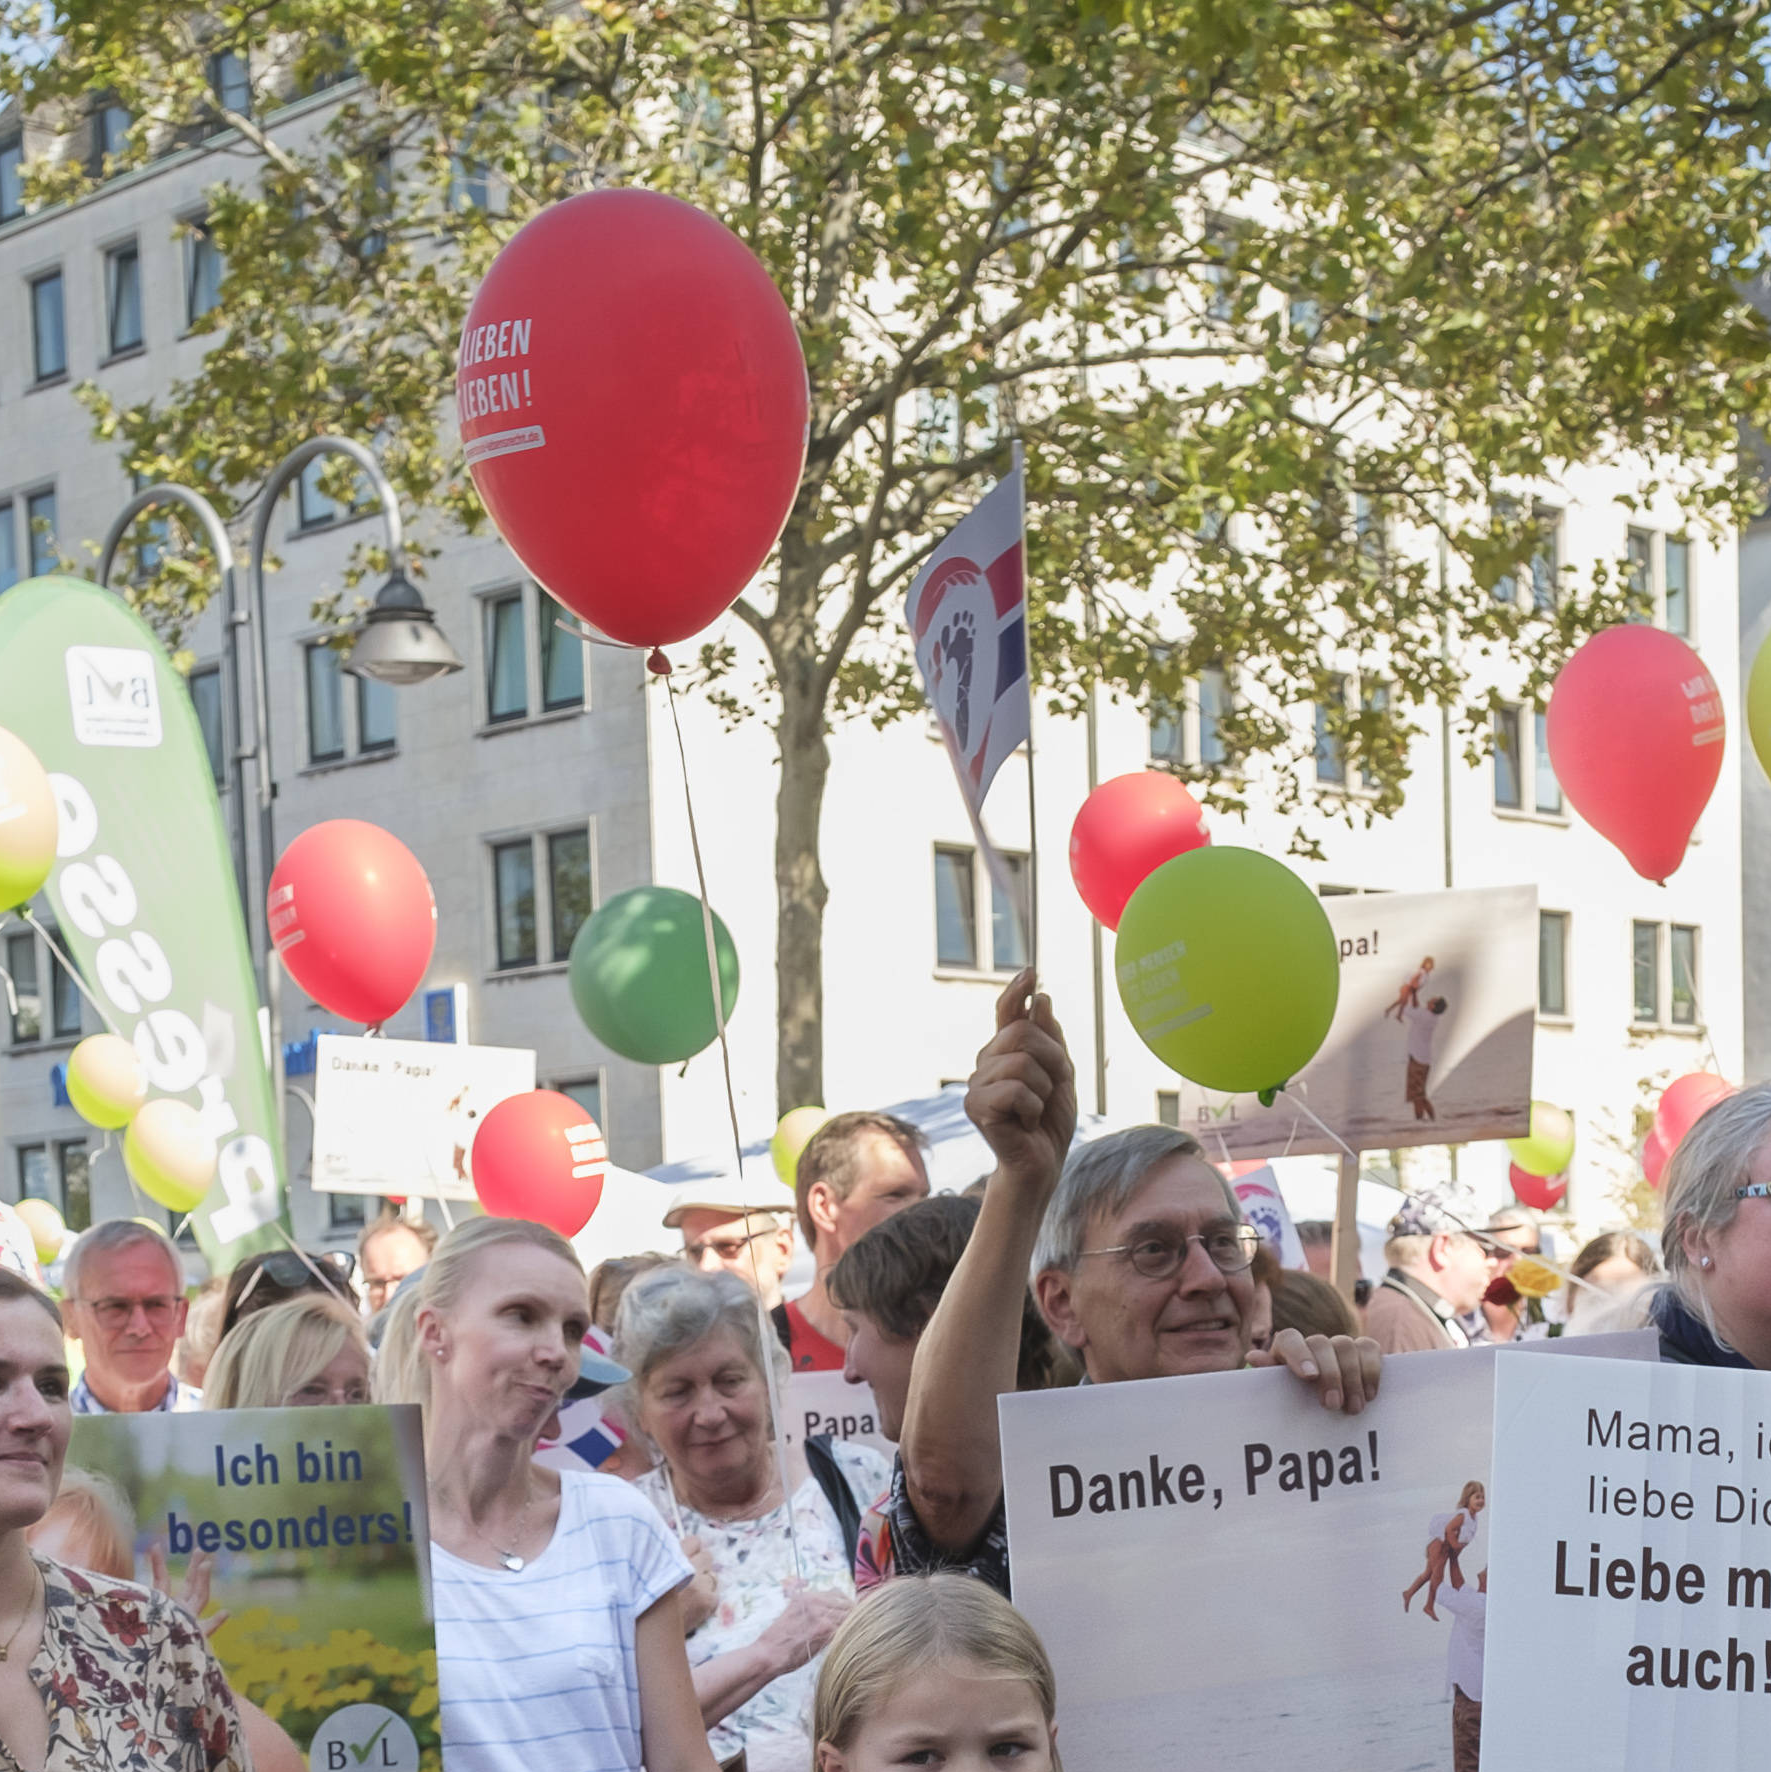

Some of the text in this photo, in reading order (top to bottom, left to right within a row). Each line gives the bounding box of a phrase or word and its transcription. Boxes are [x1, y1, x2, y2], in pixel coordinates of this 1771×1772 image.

[1340, 930, 1379, 963] pa!
[1587, 1408, 1734, 1463] Mama,
[215, 1440, 362, 1487] Ich bin
[1049, 1430, 1380, 1518] Danke, Papa!
[1589, 1475, 1694, 1520] liebe
[168, 1501, 413, 1554] besonders!
[1555, 1540, 1705, 1604] Liebe
